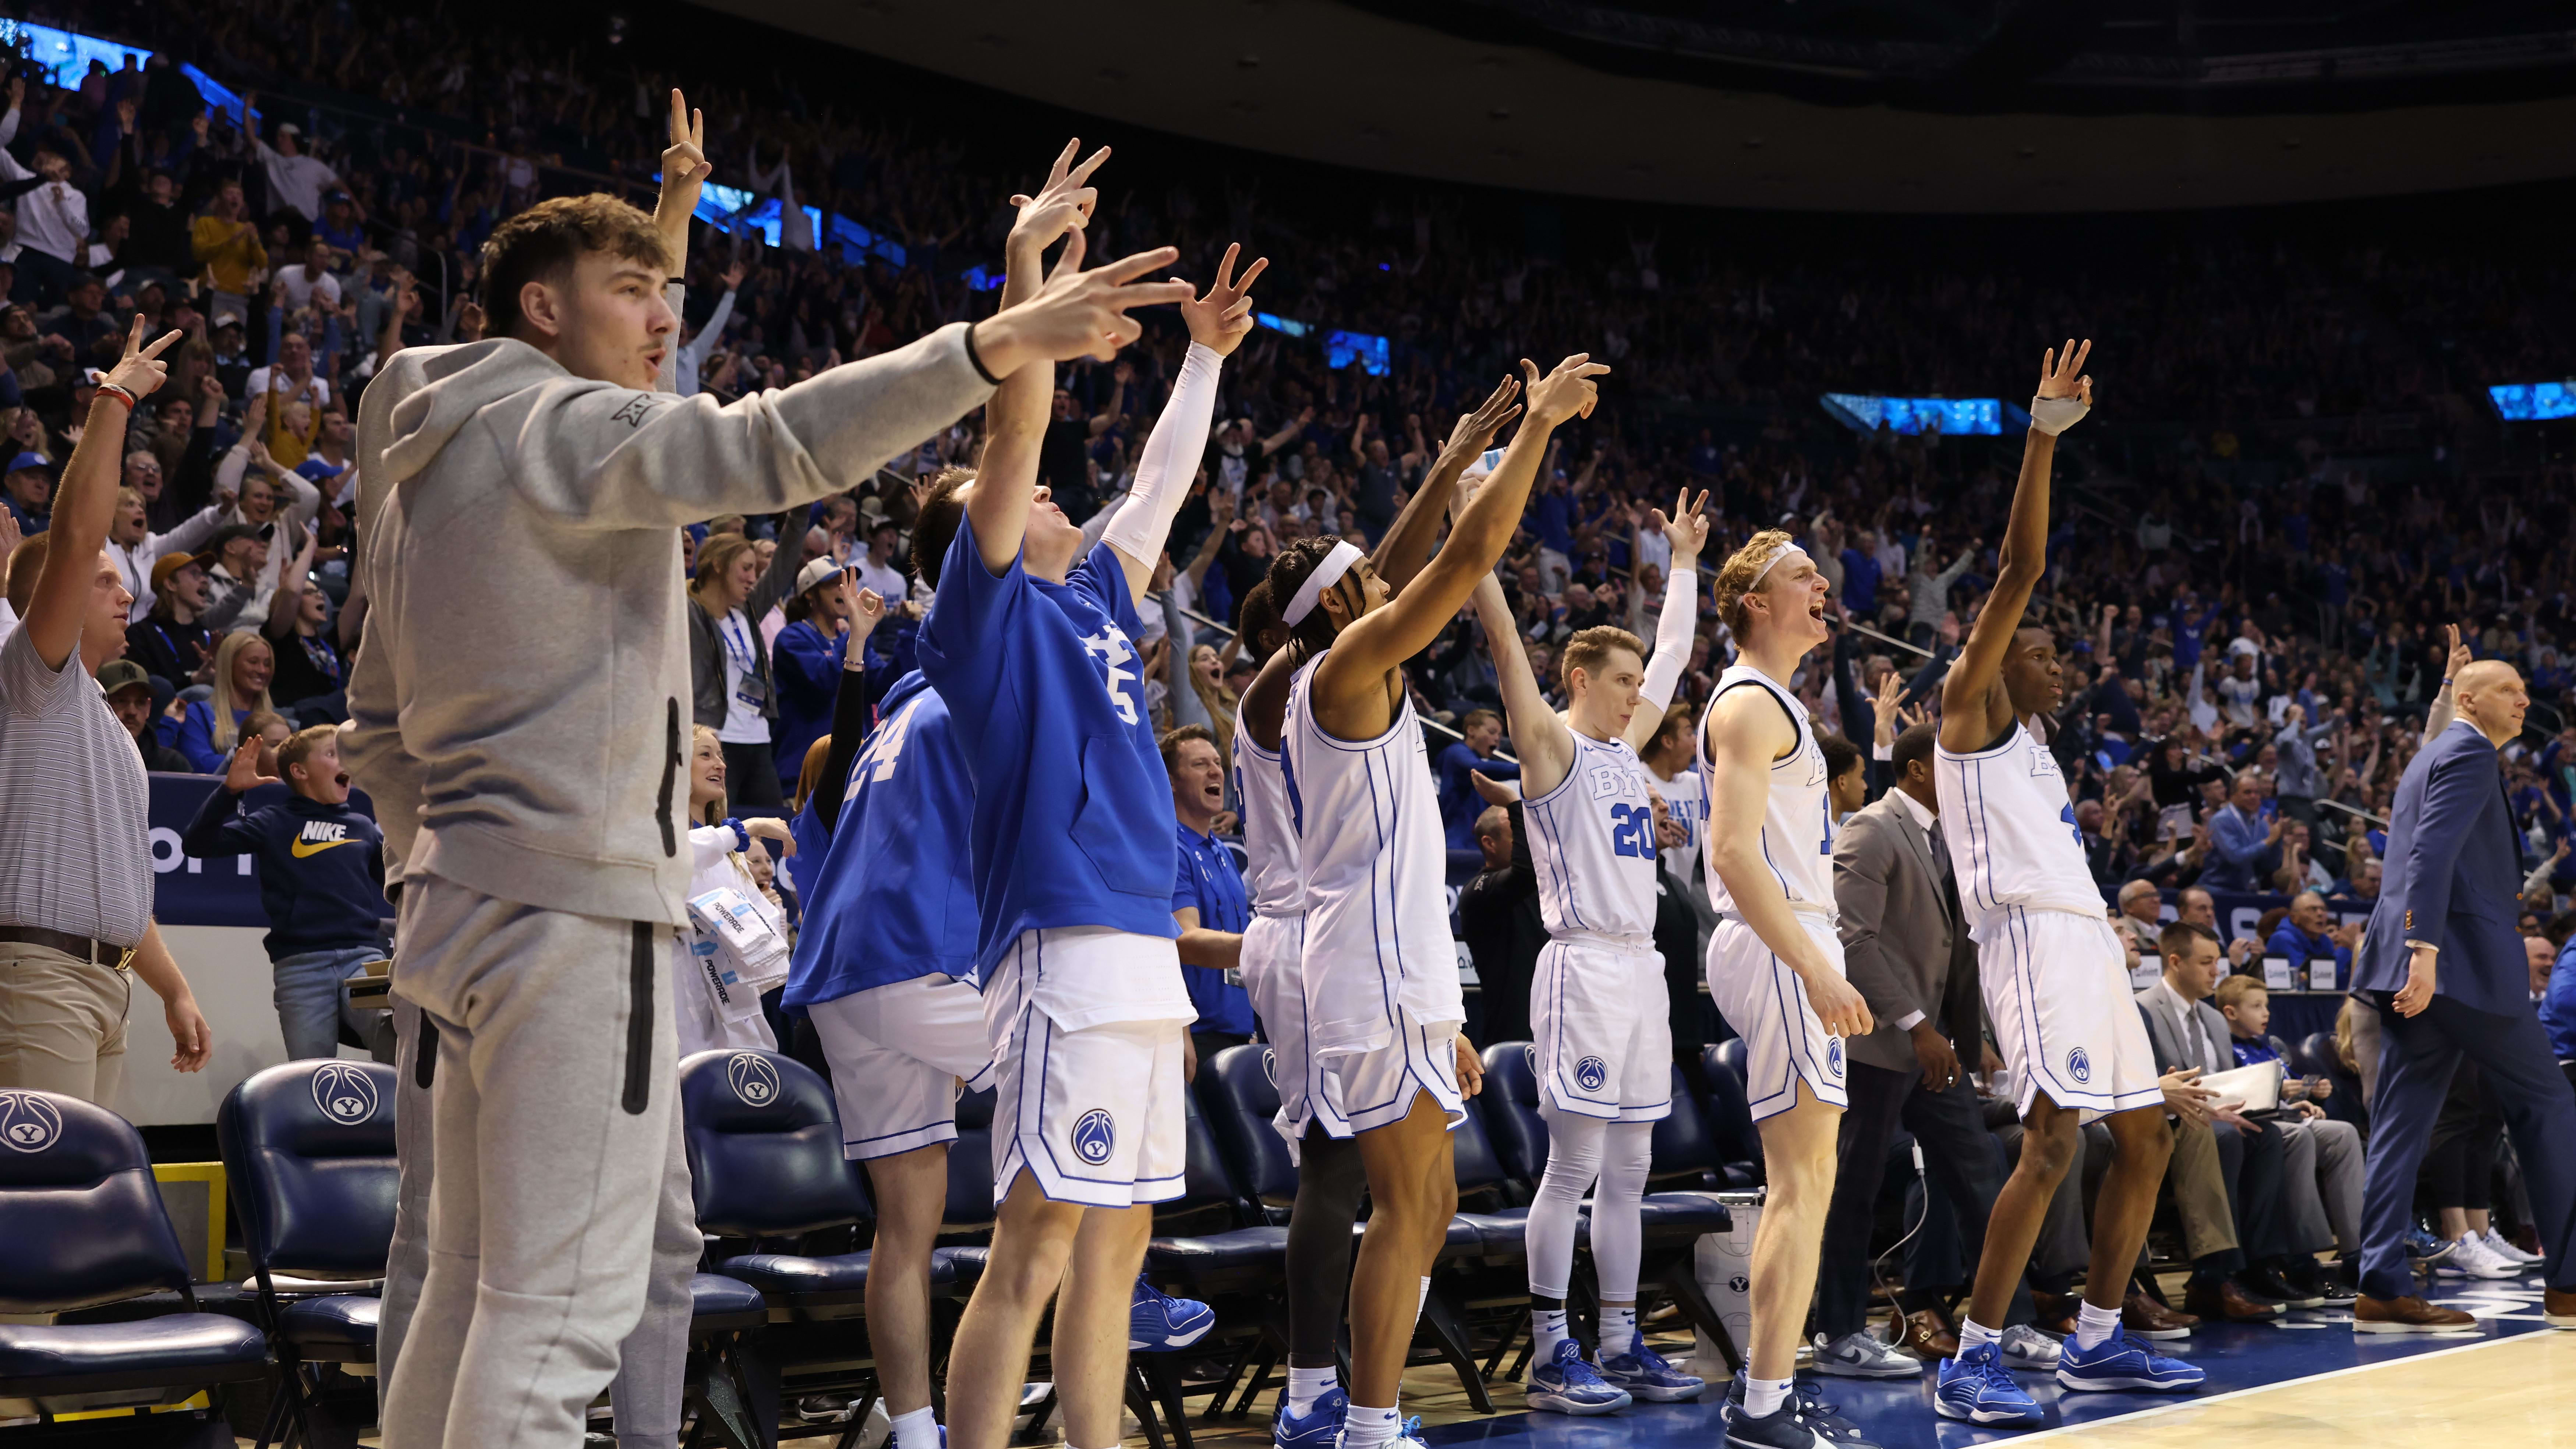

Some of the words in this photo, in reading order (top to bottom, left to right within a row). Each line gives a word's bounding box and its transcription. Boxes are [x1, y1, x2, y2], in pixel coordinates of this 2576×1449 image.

[843, 698, 924, 799] 24
[301, 821, 347, 841] NIKE
[1611, 803, 1656, 860] 20
[713, 902, 745, 934] POWERADE
[705, 959, 730, 1006] POWERADE
[1586, 1077, 1596, 1085] Y
[749, 1085, 764, 1097] Y
[338, 1099, 358, 1114] Y
[16, 1126, 39, 1141] Y
[1090, 1144, 1103, 1155] Y
[1732, 1279, 1748, 1291] Y
